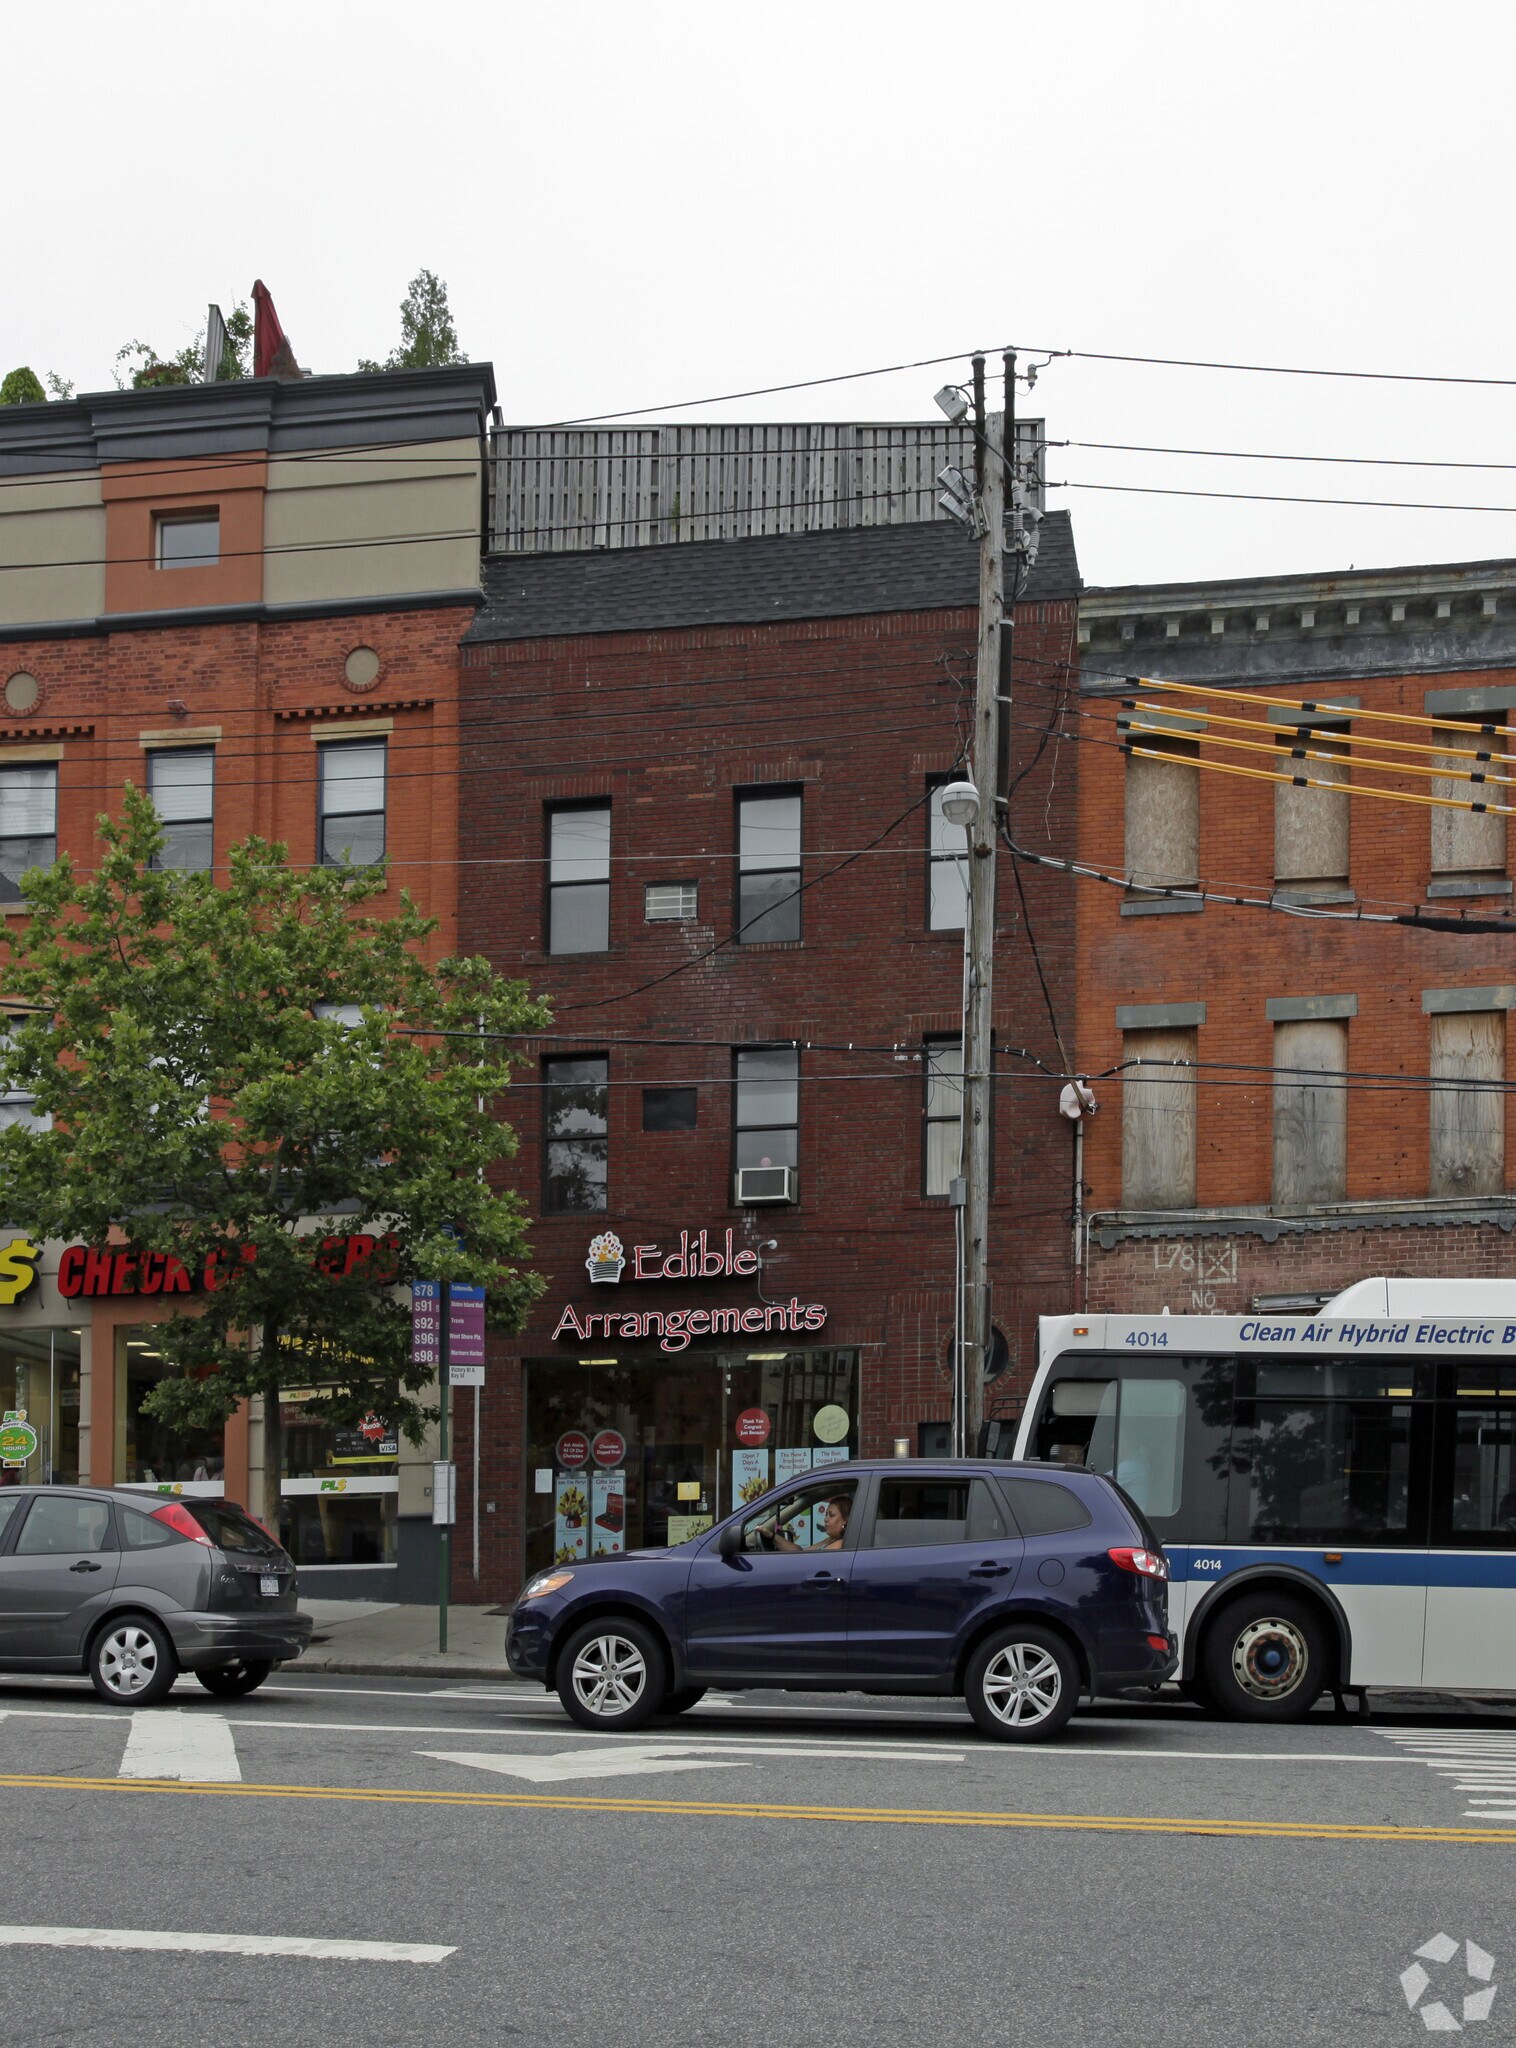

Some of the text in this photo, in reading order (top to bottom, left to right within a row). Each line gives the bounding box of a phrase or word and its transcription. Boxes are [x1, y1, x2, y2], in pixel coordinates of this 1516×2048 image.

[633, 1228, 757, 1279] Edible
[414, 1285, 433, 1296] S78
[1192, 1290, 1216, 1309] NO
[415, 1300, 432, 1312] S91
[414, 1318, 433, 1329] S92
[552, 1297, 827, 1352] Arrangements
[414, 1333, 434, 1345] S96
[1125, 1331, 1168, 1347] 4014
[1239, 1323, 1296, 1342] Clean
[1301, 1323, 1332, 1342] Air
[1339, 1324, 1409, 1347] Hybrid
[1415, 1325, 1494, 1344] Electric
[414, 1350, 433, 1362] S98
[2, 1436, 28, 1446] 24
[1194, 1559, 1222, 1570] 4014
